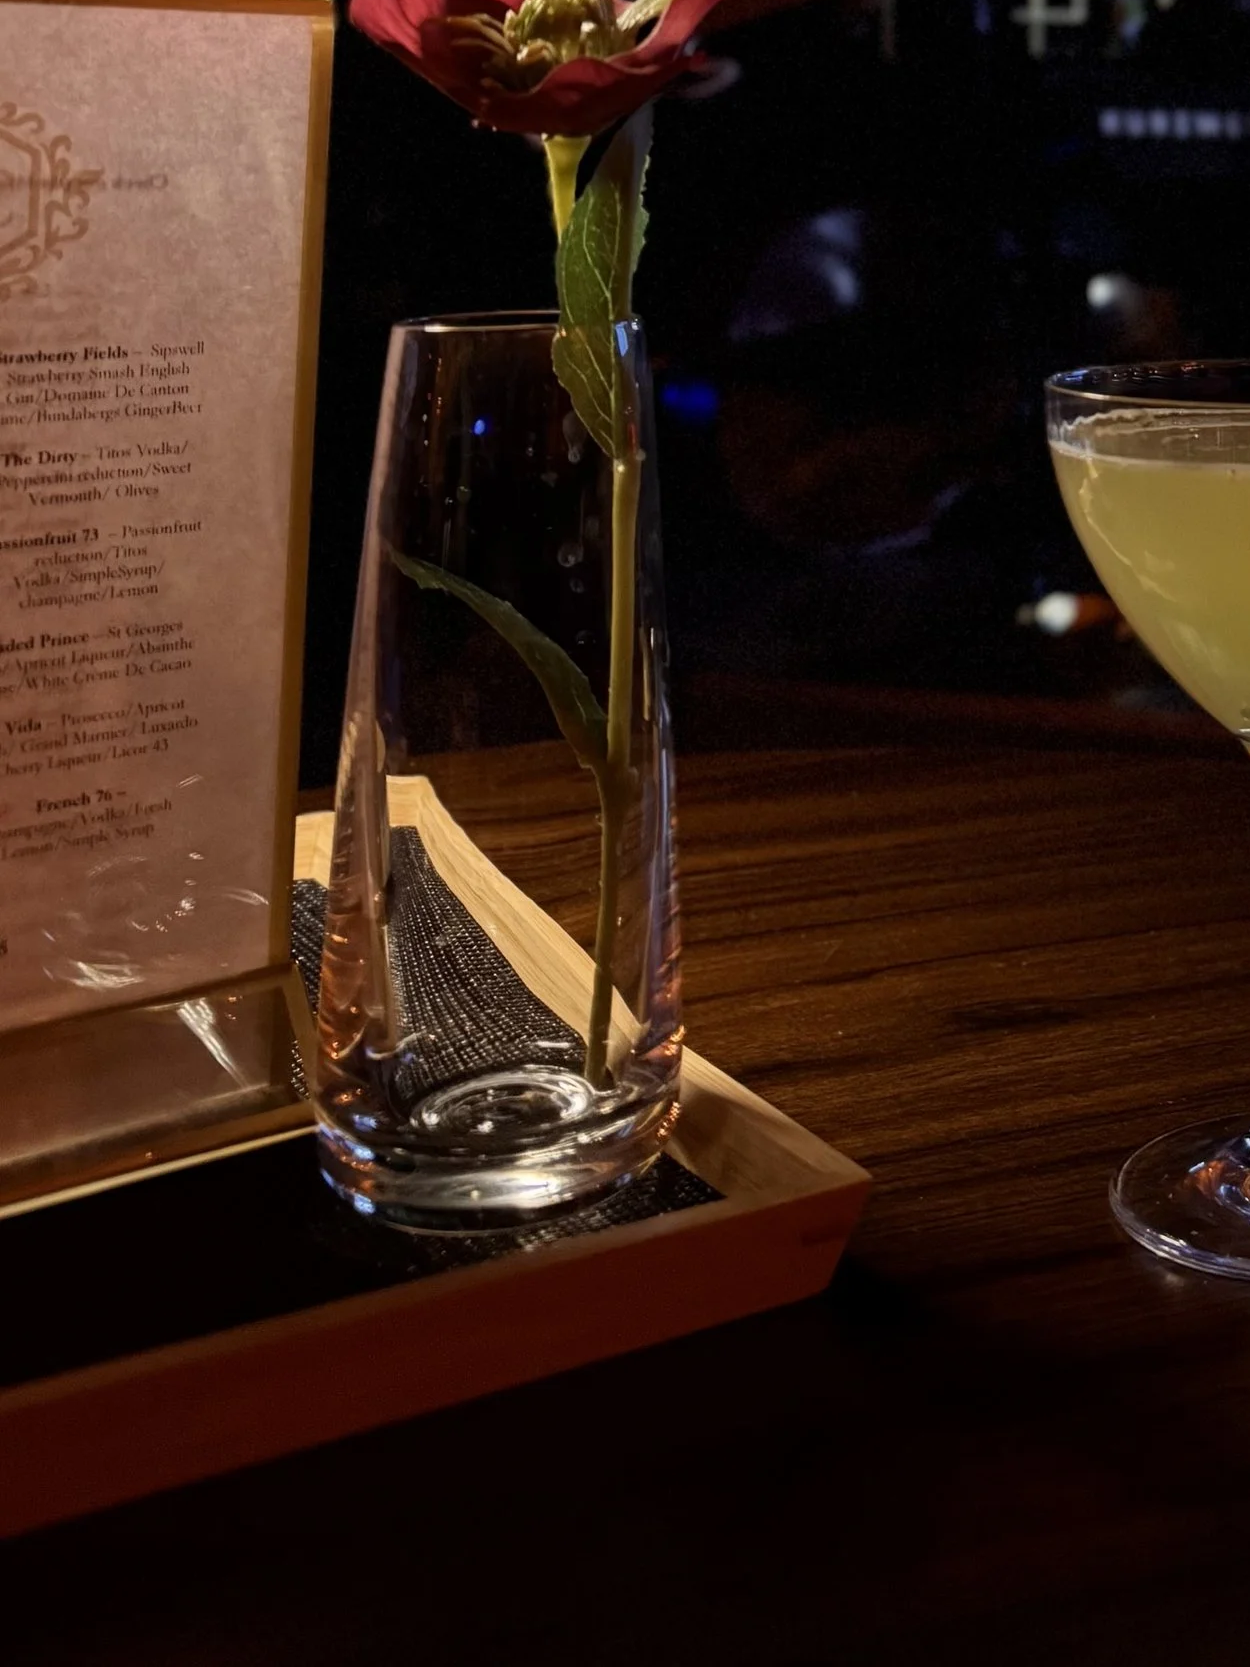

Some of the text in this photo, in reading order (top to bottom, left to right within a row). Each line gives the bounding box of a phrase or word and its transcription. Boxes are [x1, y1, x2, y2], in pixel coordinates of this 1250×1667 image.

[83, 346, 129, 361] Fields
[7, 362, 190, 385] Strawberry Smash English
[115, 384, 135, 398] De
[140, 383, 189, 398] Canton
[1, 452, 32, 467] The
[39, 449, 78, 465] Dirty
[97, 445, 131, 461] Titos
[116, 483, 159, 498] Olives
[0, 529, 77, 549] ssionfruit
[82, 528, 99, 542] 73
[123, 520, 202, 539] Passionfruit
[0, 636, 34, 653] aded
[40, 631, 89, 648] Prince
[108, 626, 121, 639] St
[126, 620, 183, 637] Georges
[126, 662, 145, 676] De
[150, 659, 192, 674] Cacao
[5, 718, 42, 735] Vida
[20, 734, 67, 753] Grand
[6, 760, 42, 777] herry
[152, 737, 168, 753] 43
[36, 791, 90, 813] French
[96, 789, 112, 802] 76
